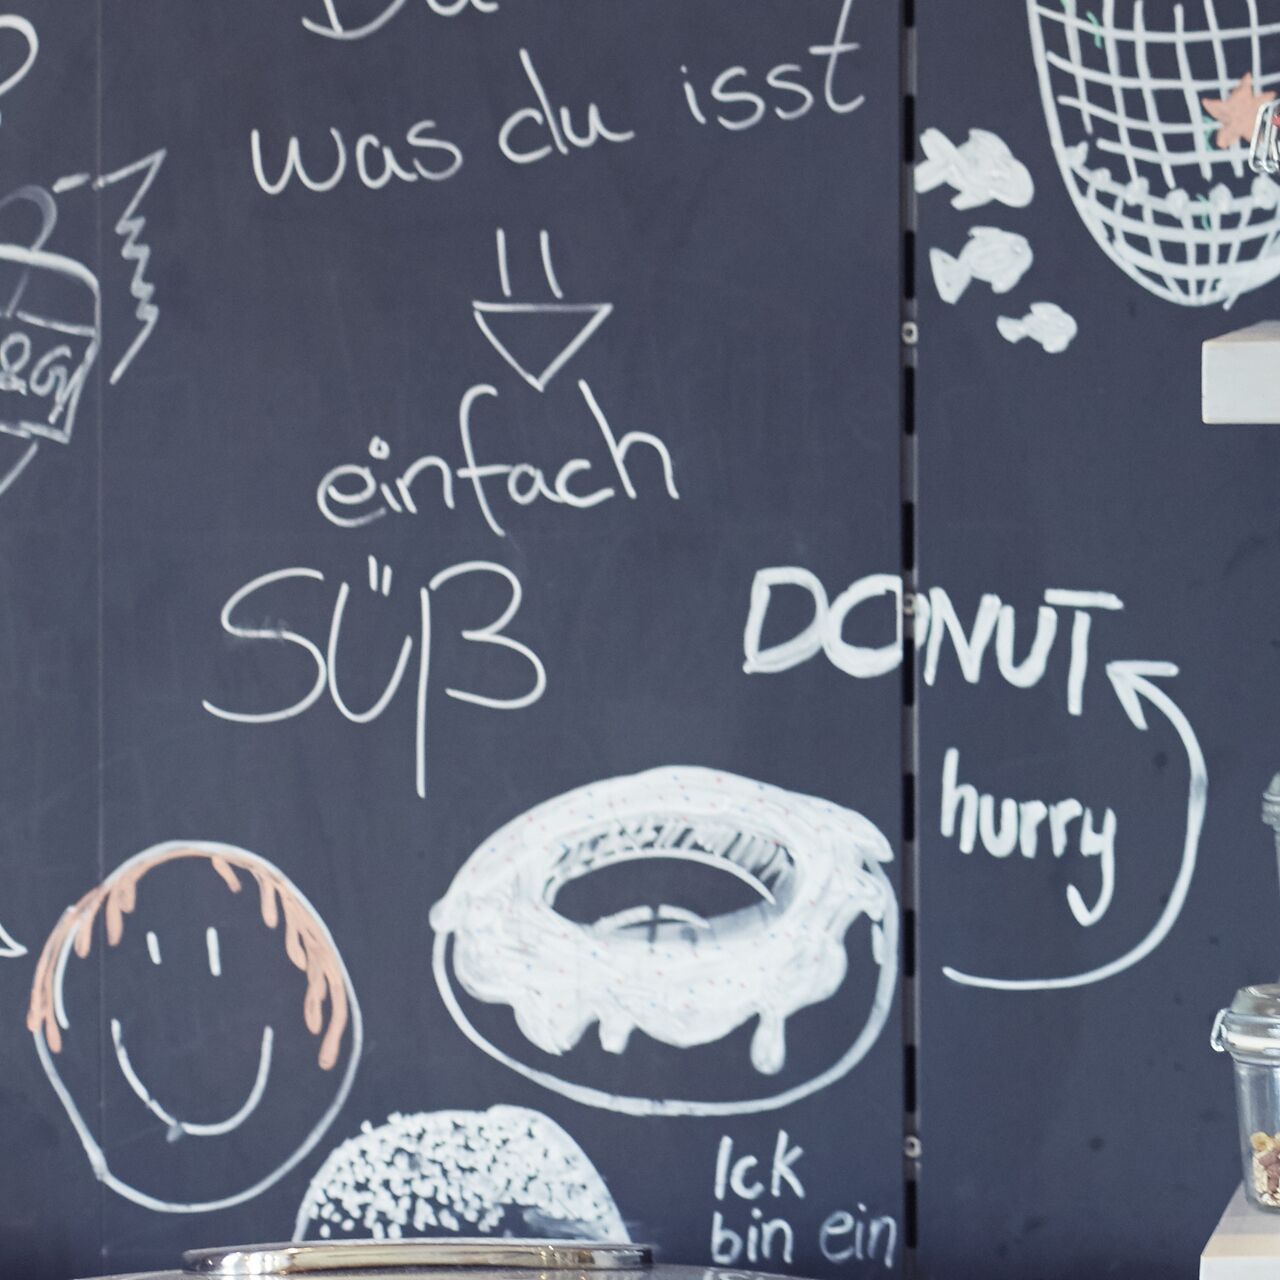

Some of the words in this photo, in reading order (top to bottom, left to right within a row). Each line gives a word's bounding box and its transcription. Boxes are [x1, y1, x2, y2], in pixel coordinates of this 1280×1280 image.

[250, 119, 464, 195] was
[498, 48, 636, 164] du
[316, 378, 680, 537] einfach
[743, 565, 1124, 716] DONUT
[940, 747, 1118, 927] hurry
[710, 1206, 793, 1266] bin
[818, 1201, 899, 1269] ein
